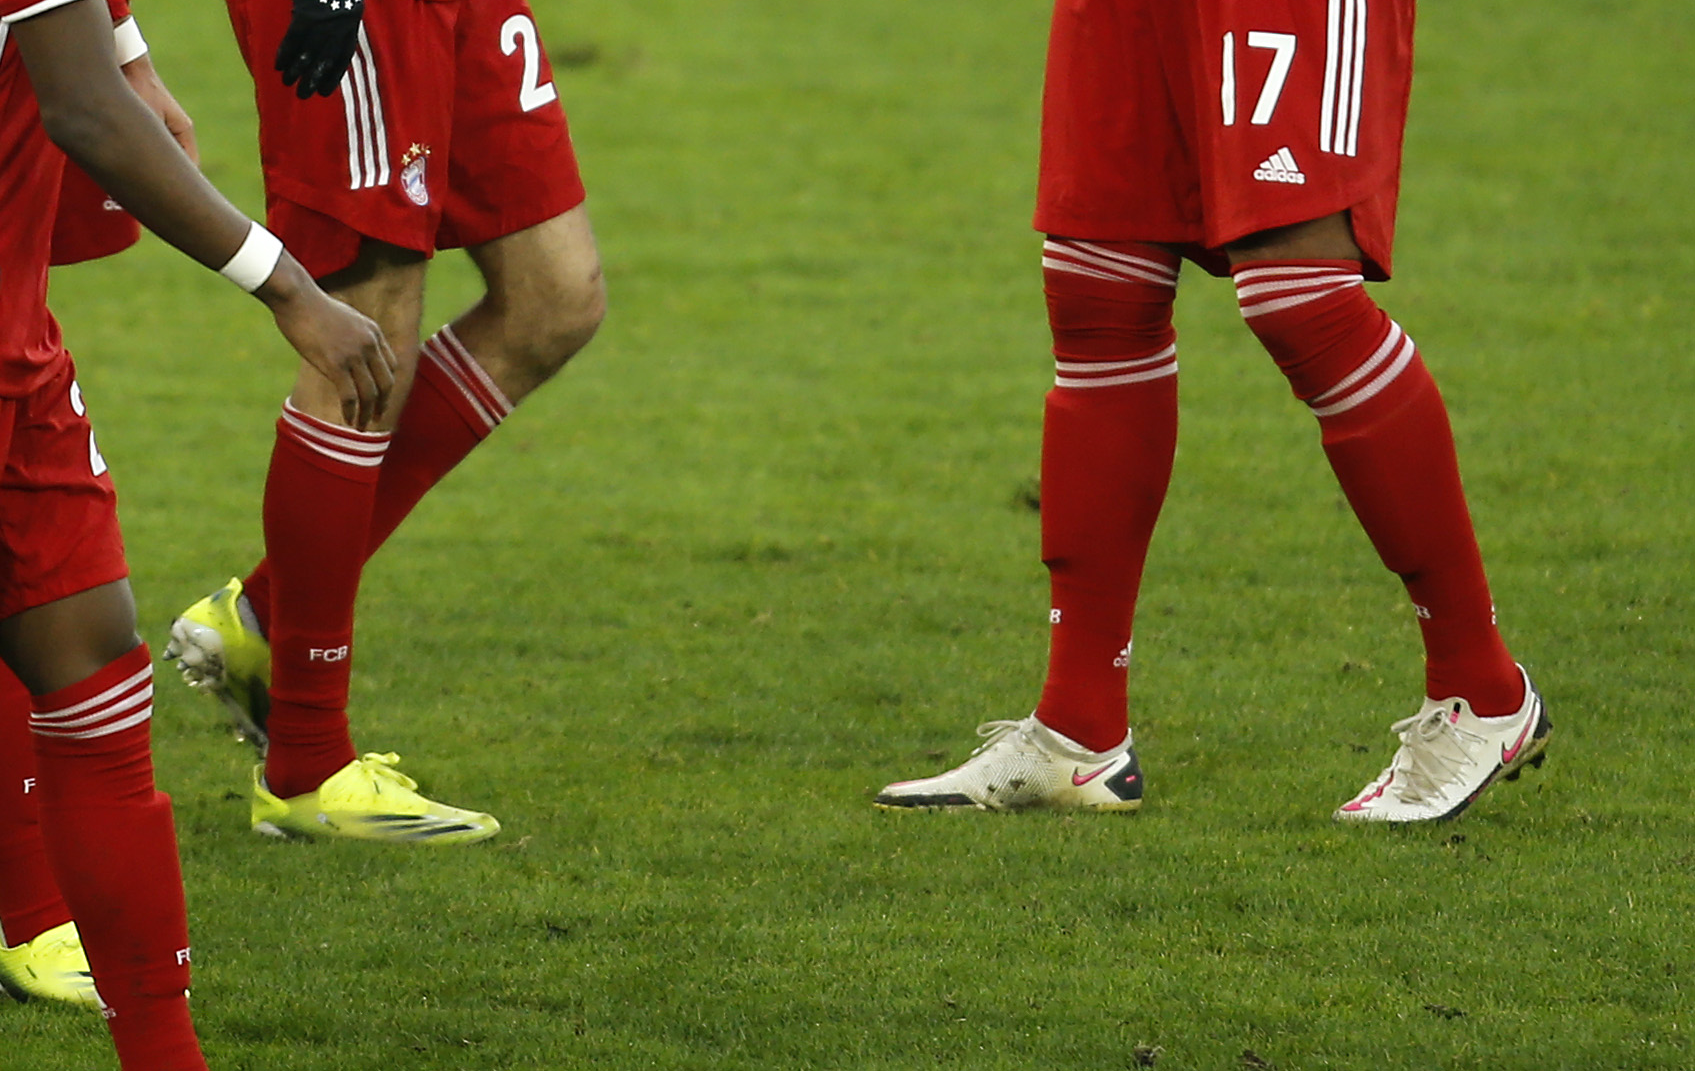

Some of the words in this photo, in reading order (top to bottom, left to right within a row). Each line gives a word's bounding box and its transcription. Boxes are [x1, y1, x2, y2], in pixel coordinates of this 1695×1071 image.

[1221, 31, 1298, 127] 17
[1253, 168, 1306, 185] adidas
[309, 645, 349, 662] FCB
